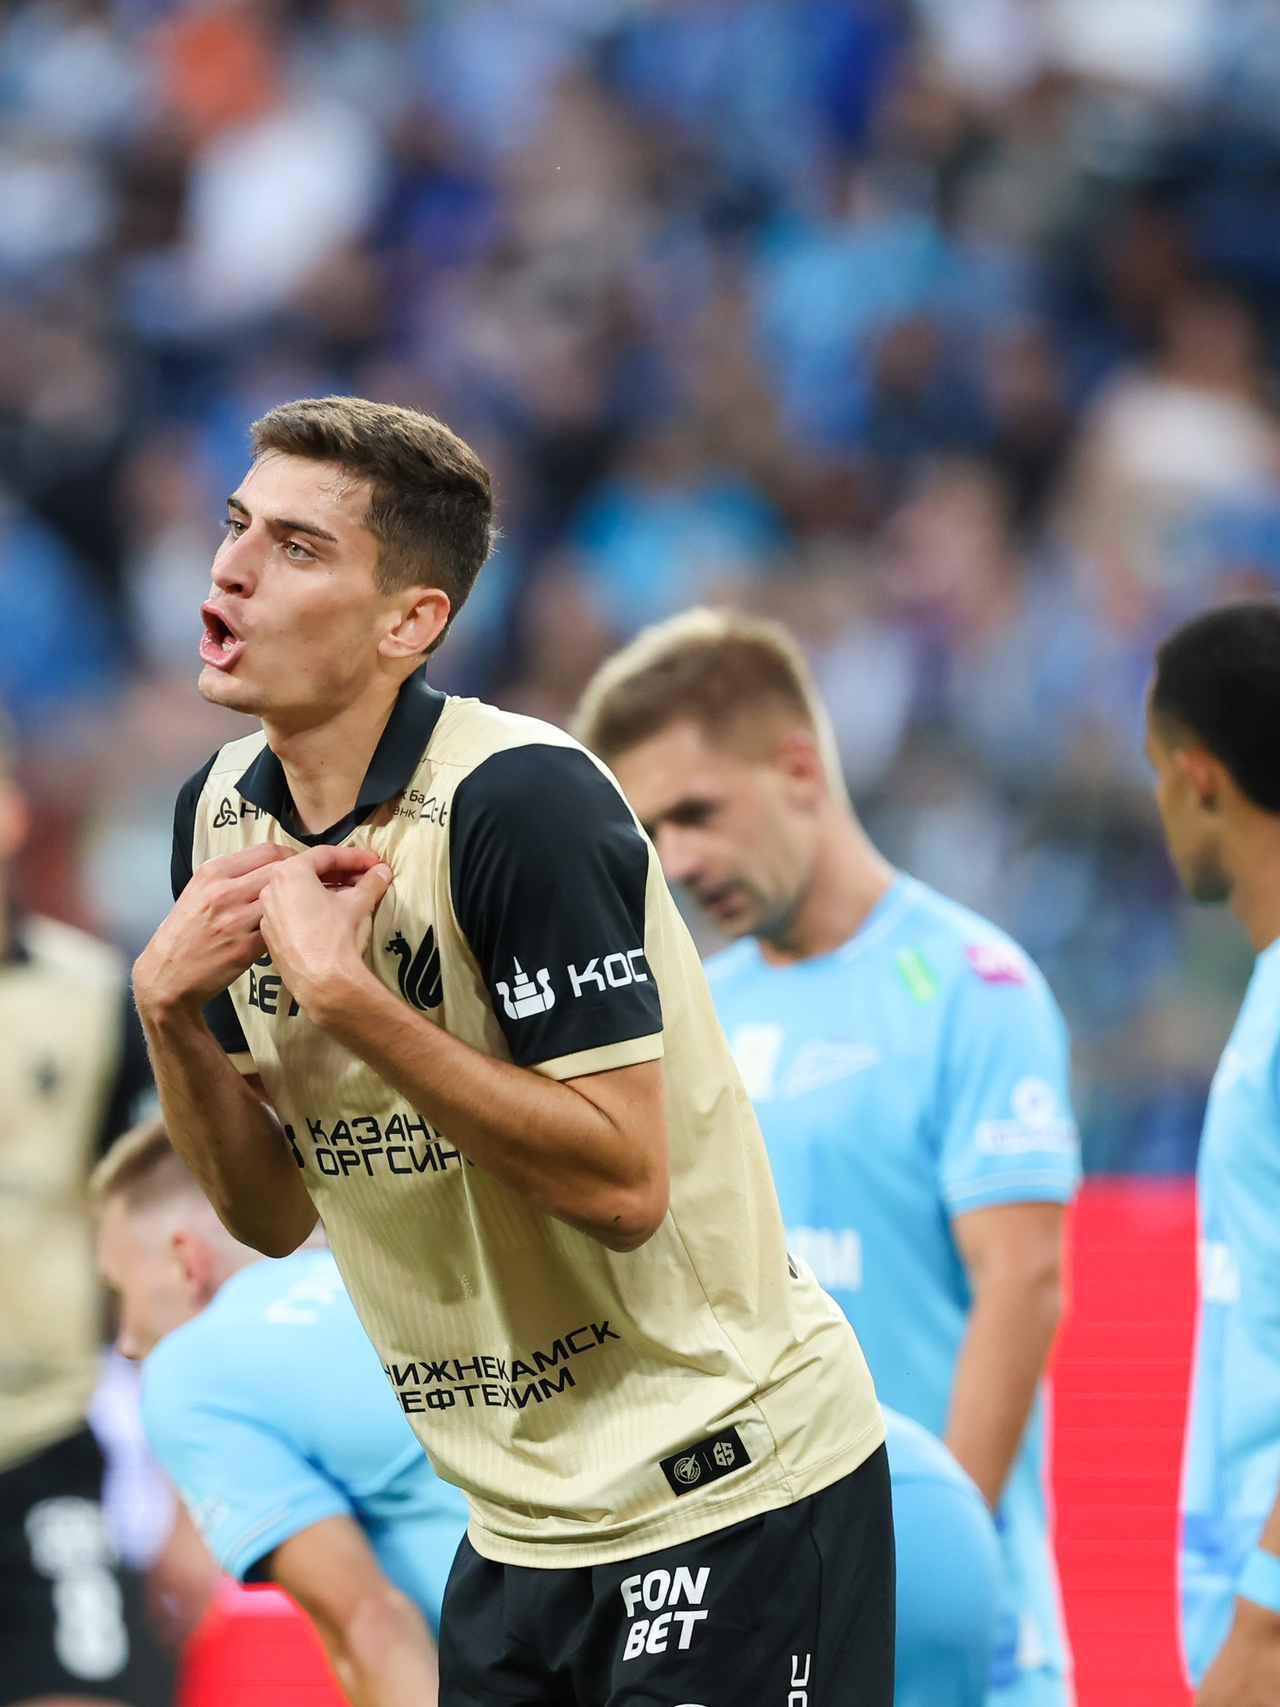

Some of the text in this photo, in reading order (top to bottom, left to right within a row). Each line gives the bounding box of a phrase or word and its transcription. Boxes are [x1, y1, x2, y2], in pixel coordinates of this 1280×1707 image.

[393, 805, 416, 820] анк
[409, 789, 425, 804] Ба
[316, 1142, 475, 1177] ОРГСИН
[396, 1366, 576, 1414] ЕФТЕХИМ
[713, 1441, 735, 1466] 65
[620, 1566, 711, 1618] FON
[622, 1609, 709, 1661] BET
